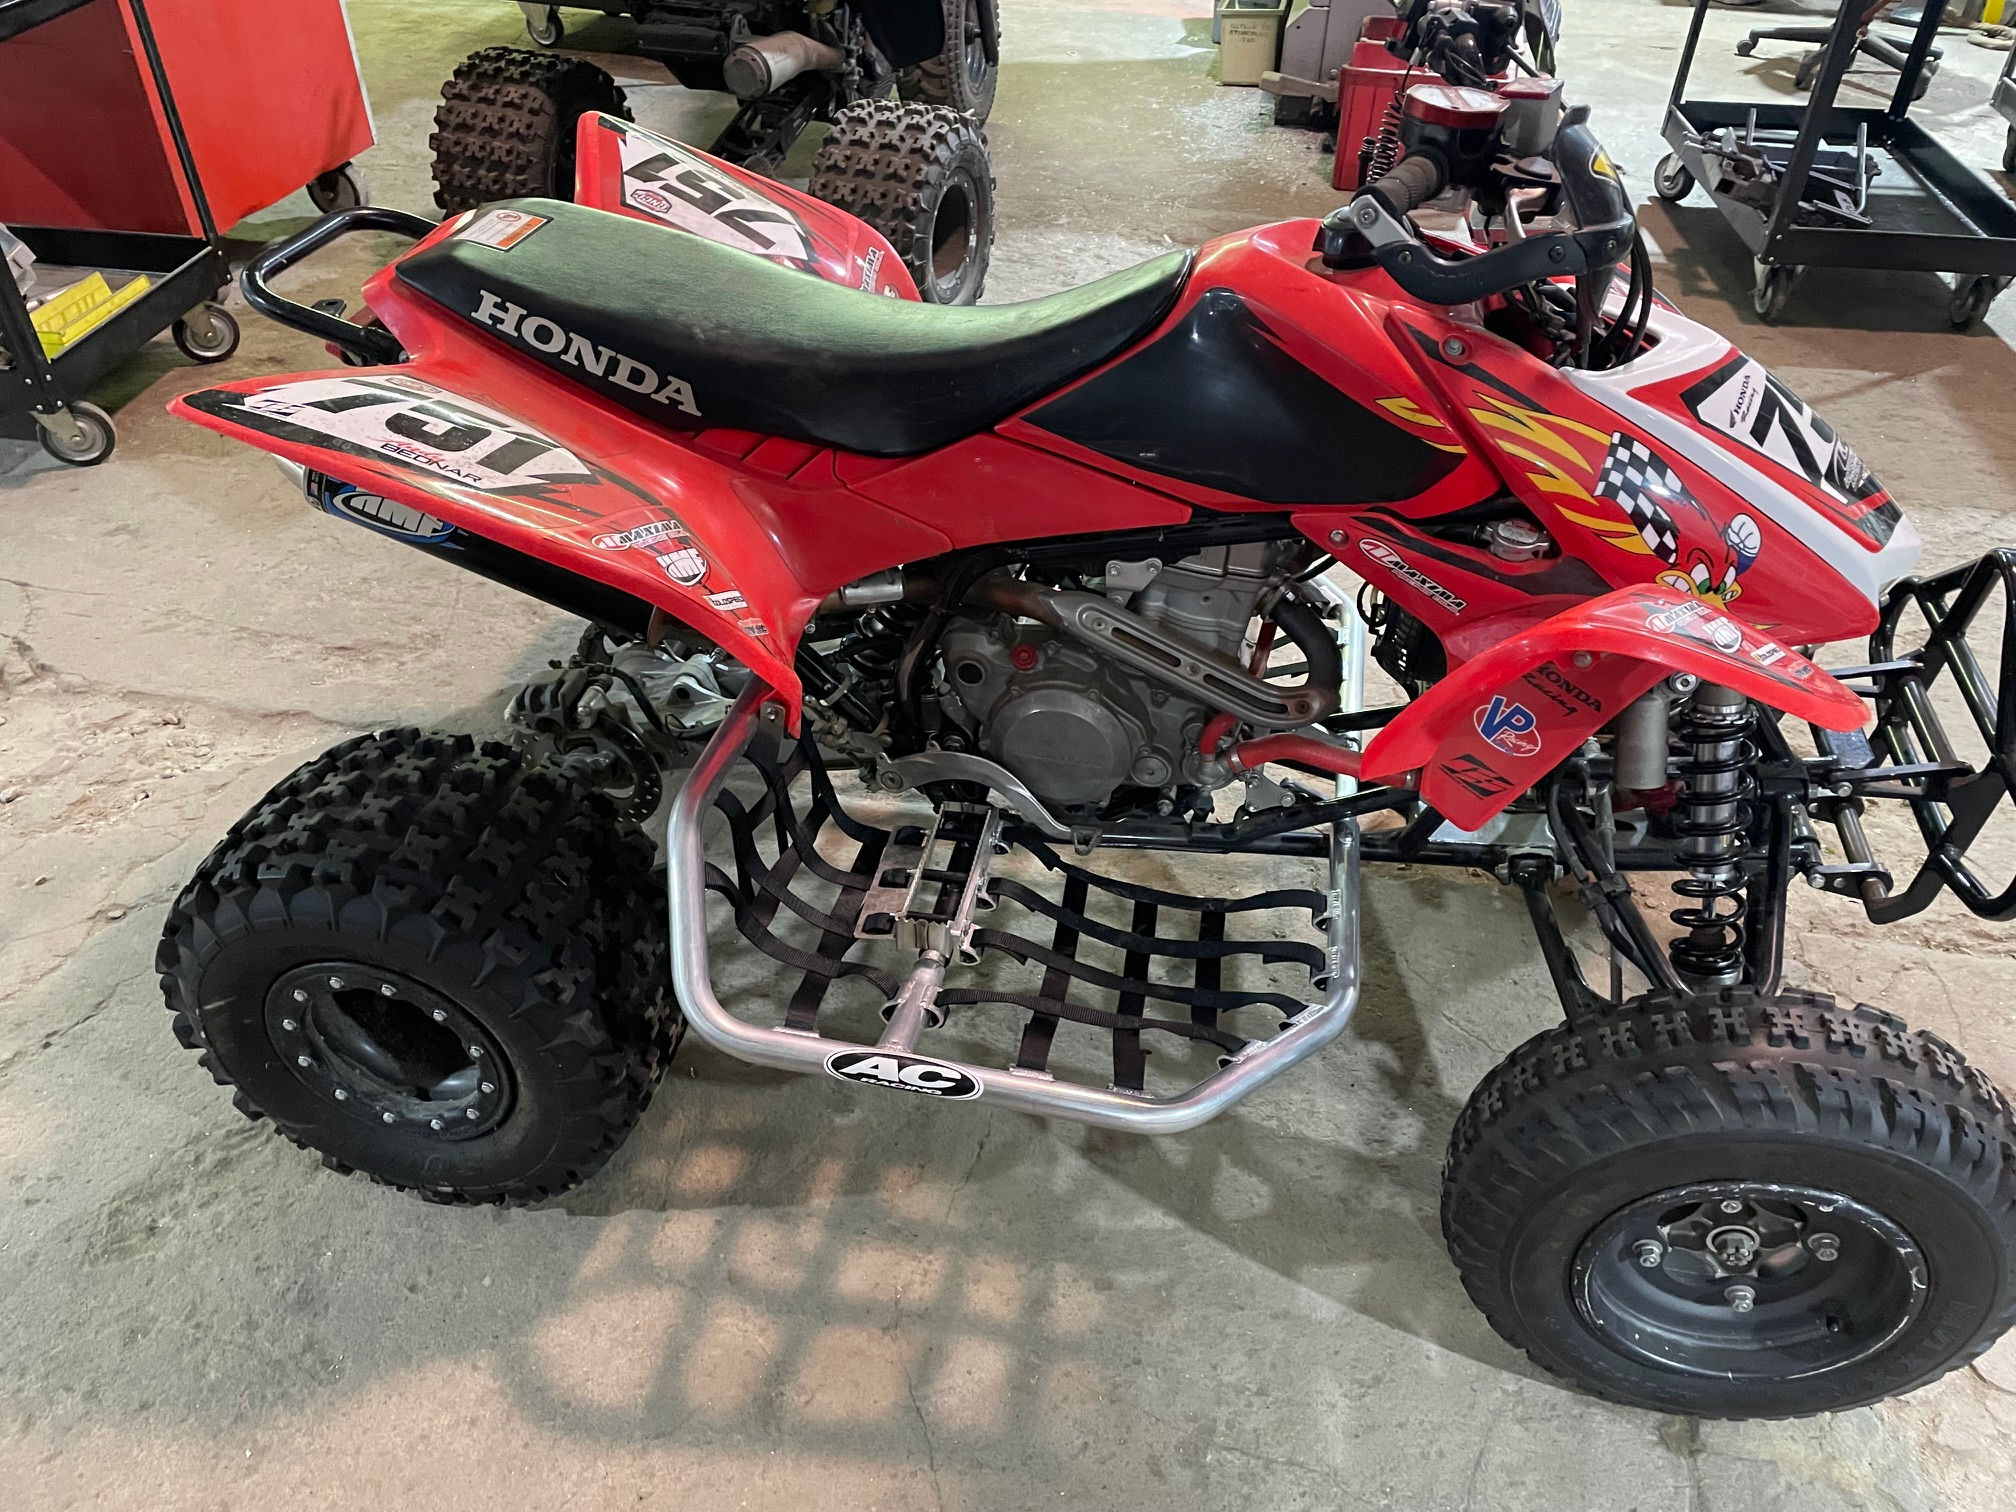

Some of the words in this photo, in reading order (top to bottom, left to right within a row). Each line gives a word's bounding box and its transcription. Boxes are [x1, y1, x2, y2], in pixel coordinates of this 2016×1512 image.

[471, 289, 702, 417] HONDA
[1733, 375, 1751, 416] HONDA
[302, 378, 556, 476] 751
[380, 442, 483, 483] BEDNAR
[619, 520, 682, 545] MAXIMA
[1385, 556, 1468, 611] MAXIMA
[1478, 694, 1536, 742] VP
[1495, 730, 1540, 752] Racing
[838, 1055, 962, 1089] AC
[860, 1077, 943, 1096] RACING
